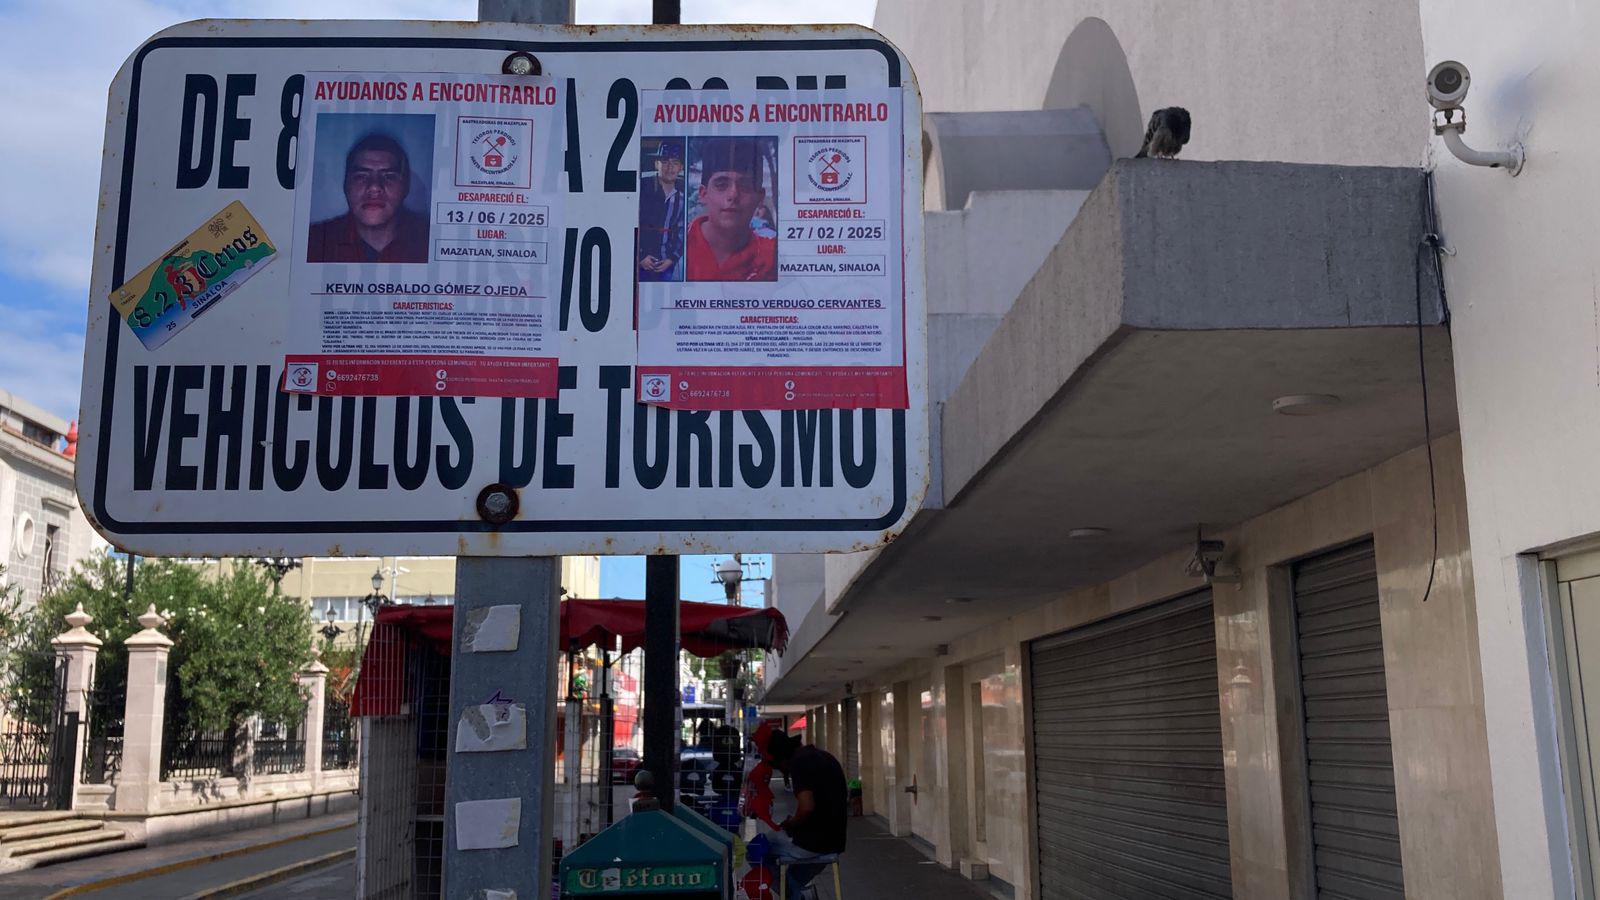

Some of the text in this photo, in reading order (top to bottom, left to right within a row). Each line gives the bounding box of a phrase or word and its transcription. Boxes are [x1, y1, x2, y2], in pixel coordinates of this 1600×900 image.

[315, 82, 556, 105] AYUDANOS A ENCONTRARLO
[654, 102, 888, 123] AYUDANOS A ENCONTRARLO
[176, 73, 256, 190] DE
[276, 73, 305, 190] 8
[472, 129, 516, 146] TESOROS PERDIDOS
[458, 191, 529, 204] DESAPARECIÓ EL:
[447, 210, 545, 225] 13 / 06 / 2025
[797, 208, 866, 218] DESAPARECIÓ EL:
[477, 229, 507, 239] LUGAR:
[787, 227, 882, 239] 27 / 02 / 2025
[196, 226, 258, 279] Ceros
[440, 247, 537, 258] MAZATLAN, SINALOA
[817, 245, 846, 254] LUGAR:
[780, 264, 881, 273] MAZATLAN, SINALOA
[192, 281, 228, 309] SINALOA
[326, 282, 528, 296] KEVIN OSBALDO GÓMEZ OJEDA
[393, 302, 455, 310] CARACTERISTICAS:
[675, 299, 882, 308] KEVIN ERNESTO VERDUGO CERVANTES
[740, 315, 799, 323] CARACTERISTICAS:
[166, 320, 177, 331] 25
[134, 366, 877, 492] VEHICULOS DE TURISMO
